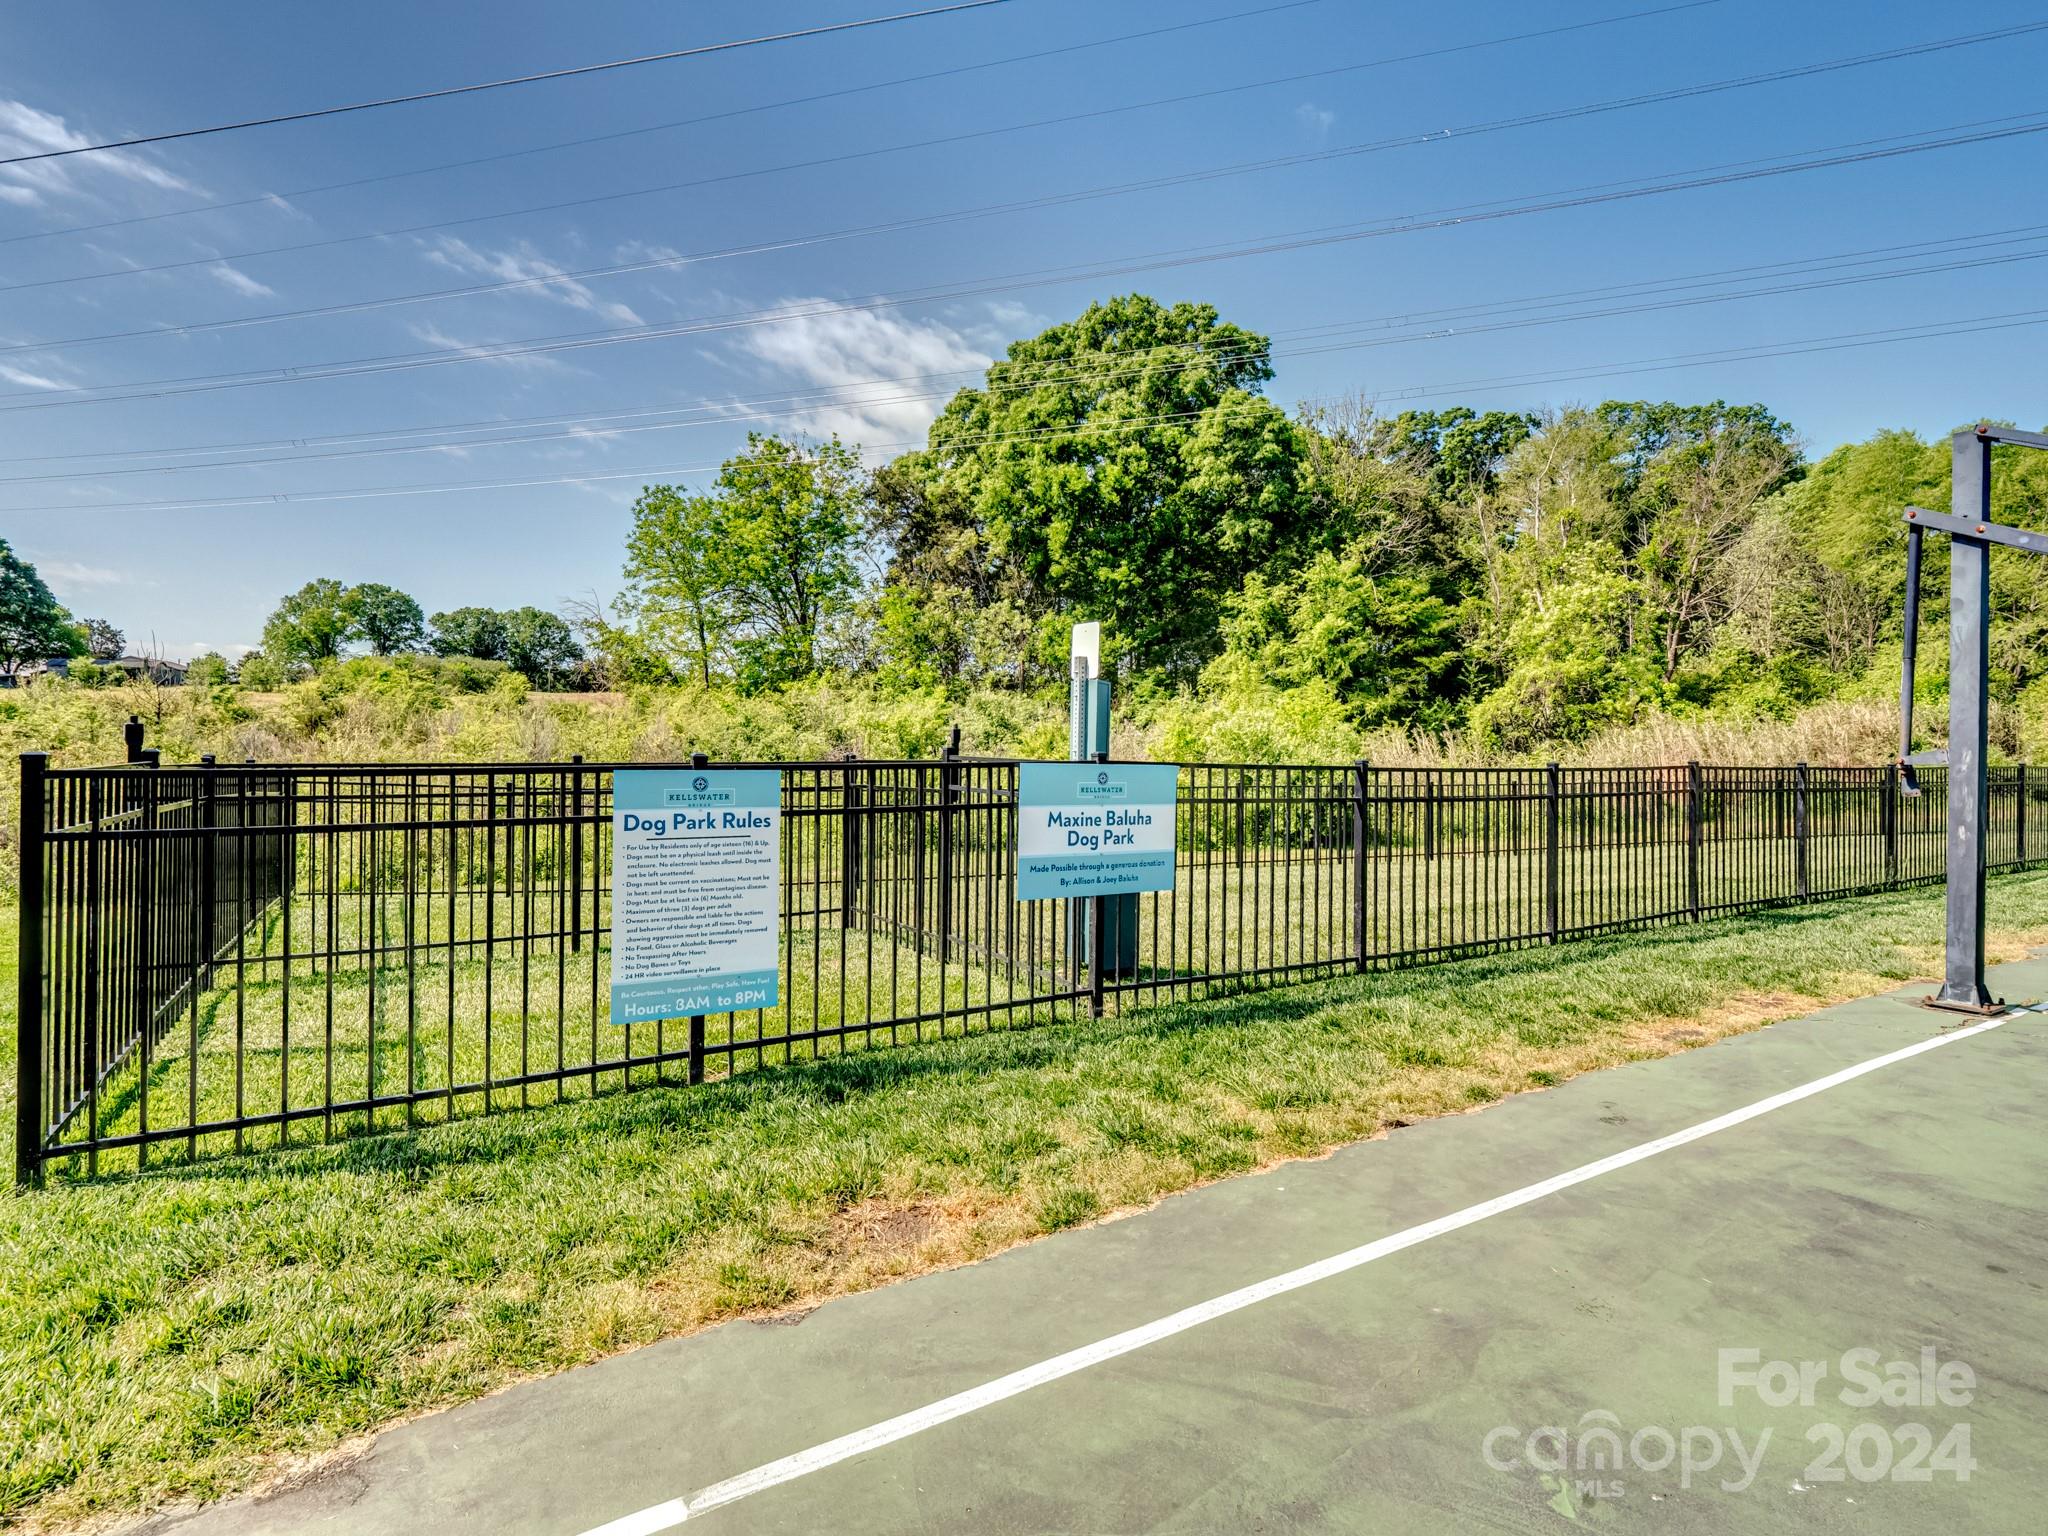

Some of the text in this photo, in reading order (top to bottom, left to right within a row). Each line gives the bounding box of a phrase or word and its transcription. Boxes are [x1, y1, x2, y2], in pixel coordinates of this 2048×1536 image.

[624, 811, 771, 836] Dog Park Rules
[1048, 809, 1152, 827] Maxine Baluha
[1068, 828, 1134, 850] Dog Park
[690, 842, 702, 850] only
[1030, 865, 1049, 873] Made
[1051, 863, 1078, 872] Possible
[1079, 861, 1104, 871] through
[1111, 862, 1138, 870] generous
[1060, 878, 1071, 887] By:
[1072, 877, 1094, 885] Allison
[1096, 876, 1101, 884] &
[1102, 875, 1117, 884] Joey
[661, 914, 694, 923] responsible
[652, 933, 684, 941] aggression
[709, 928, 743, 936] immediately
[636, 952, 670, 960] Trespassing
[664, 968, 698, 976] surveillance
[706, 966, 720, 974] place
[712, 982, 724, 990] Play
[625, 1003, 672, 1016] Hours:
[718, 995, 730, 1006] to
[735, 989, 766, 1004] 8PM
